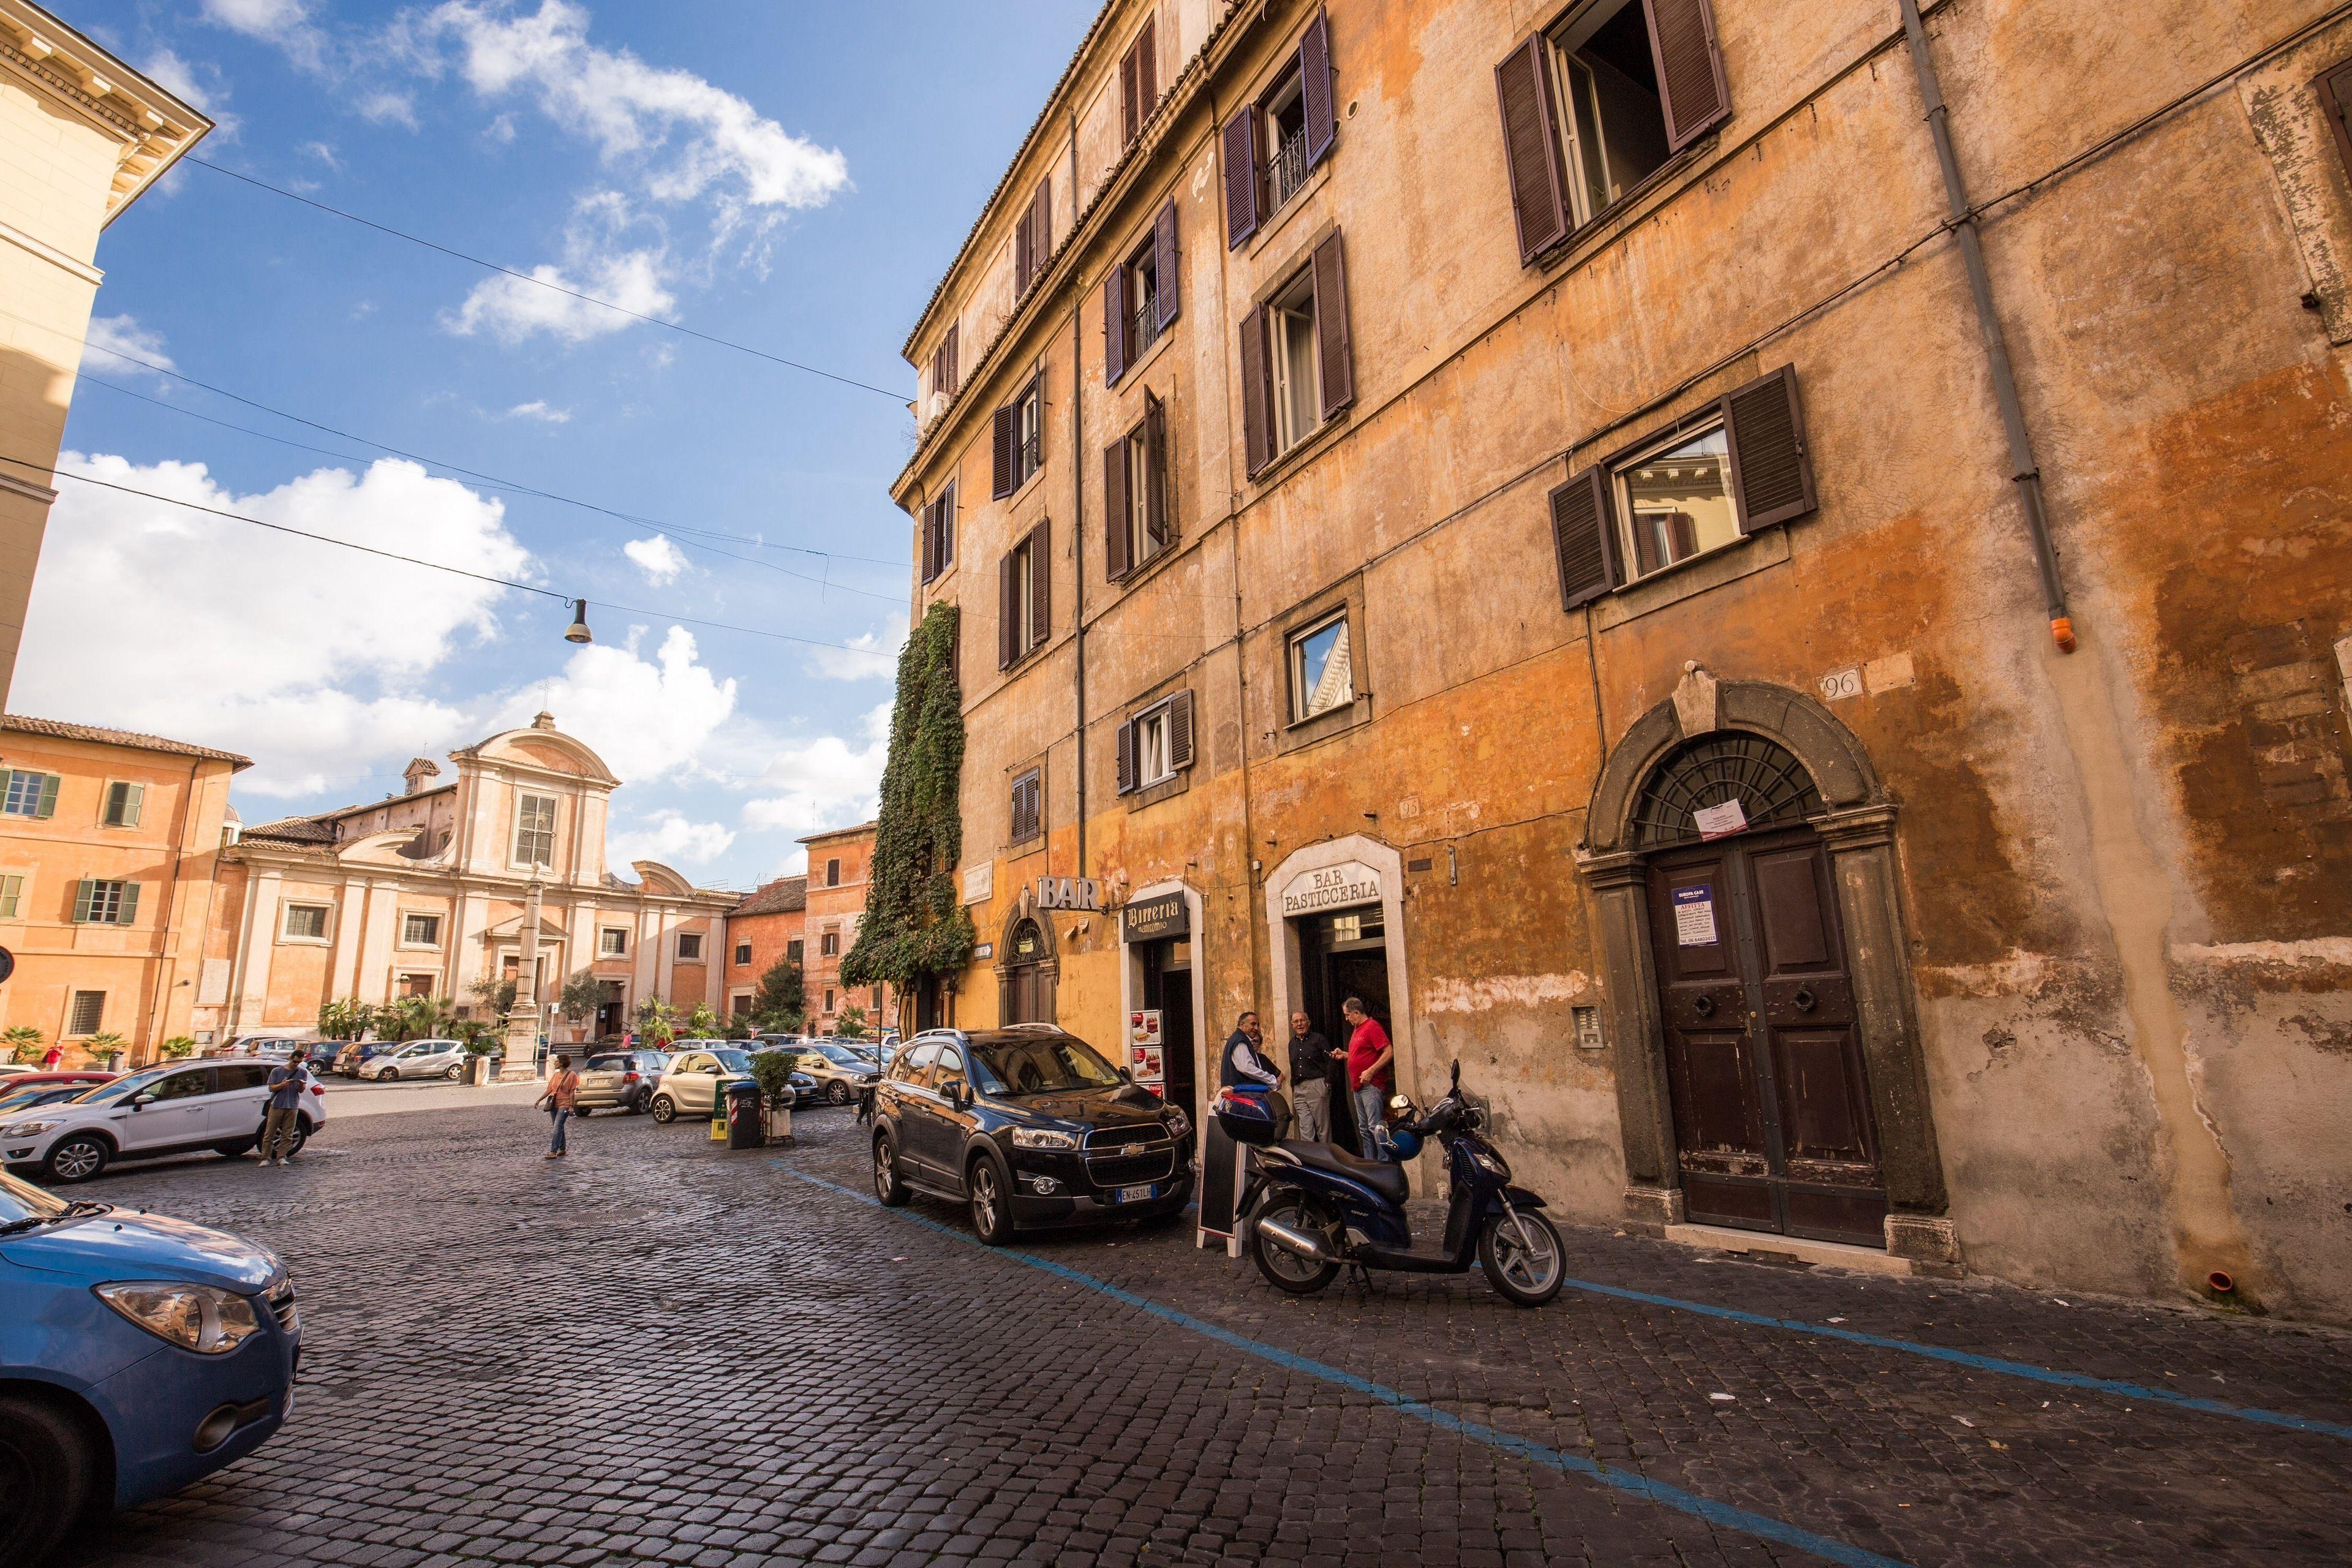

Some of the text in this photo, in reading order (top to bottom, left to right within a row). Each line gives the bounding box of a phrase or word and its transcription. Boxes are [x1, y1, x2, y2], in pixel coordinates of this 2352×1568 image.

[1825, 672, 1855, 698] 96
[1403, 799, 1417, 816] 95
[1039, 876, 1101, 910] BAR
[1313, 869, 1343, 890] BAR
[1285, 880, 1379, 912] PASTICCERIA
[1128, 900, 1178, 929] Birreria
